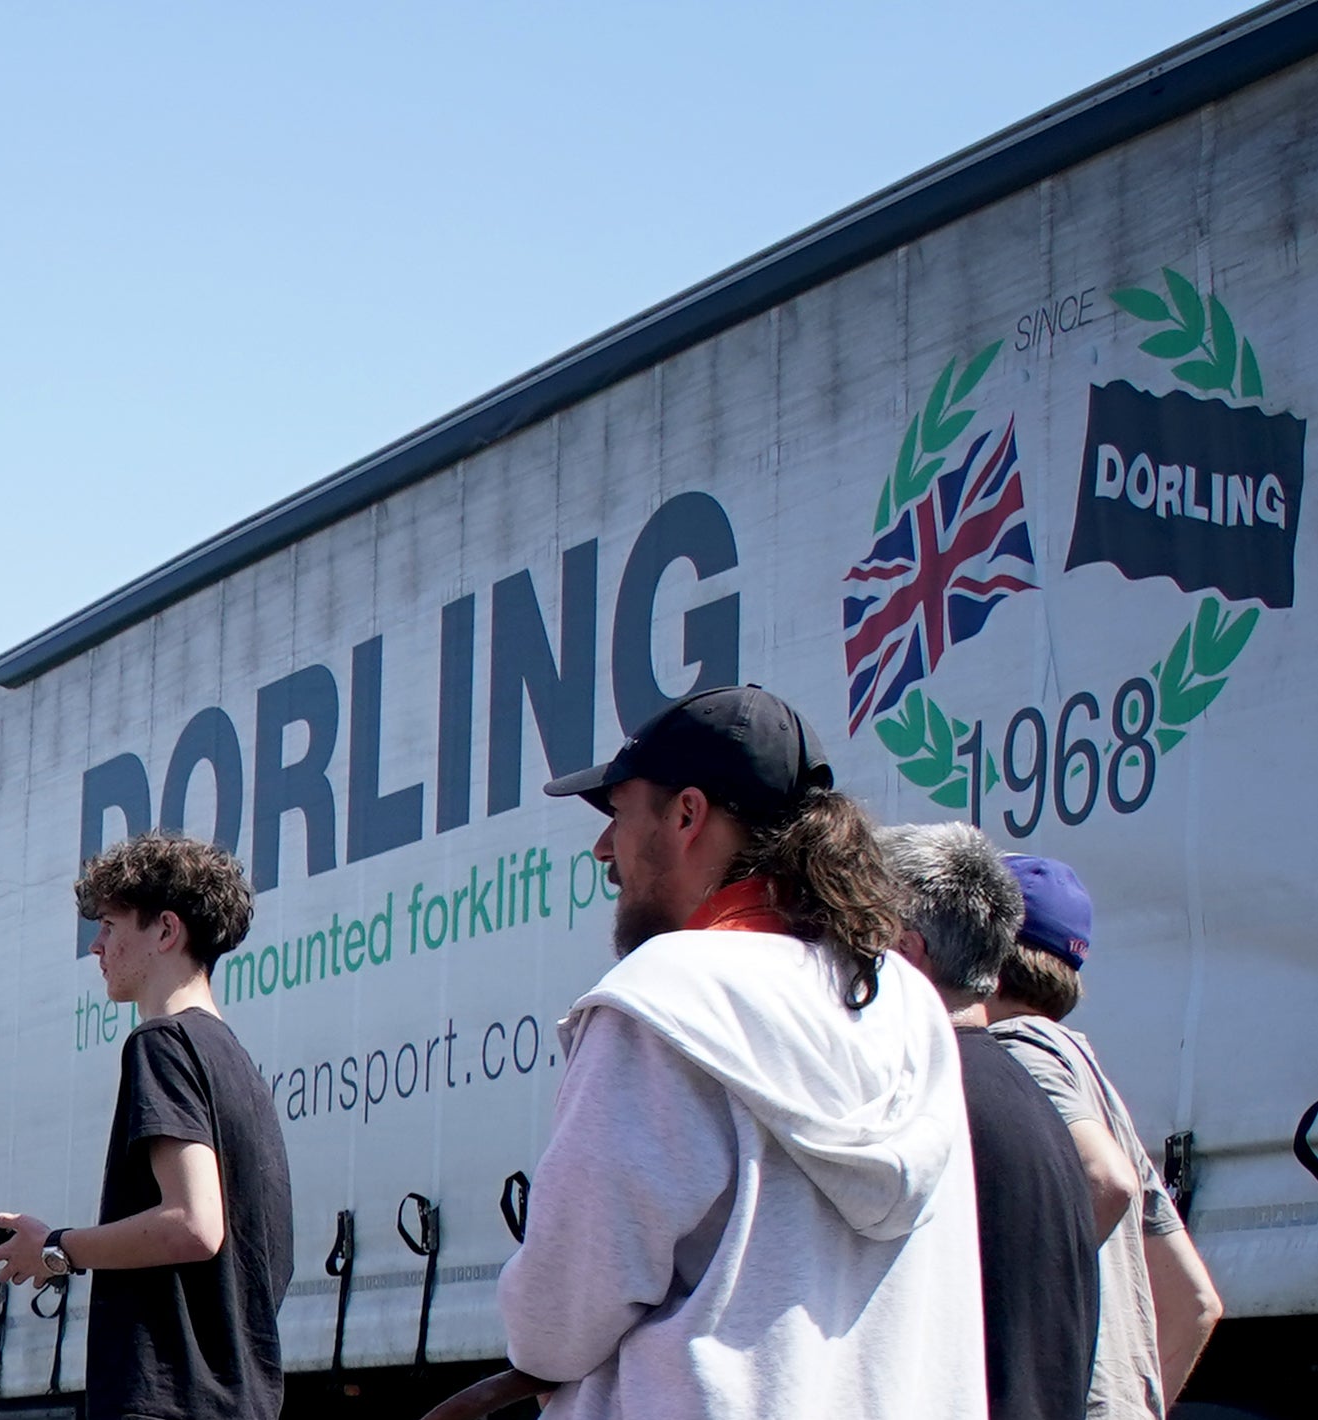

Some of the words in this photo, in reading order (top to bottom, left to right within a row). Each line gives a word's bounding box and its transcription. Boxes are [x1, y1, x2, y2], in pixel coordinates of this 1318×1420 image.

[1014, 286, 1096, 352] SINCE
[1095, 443, 1287, 530] DORLING
[76, 491, 741, 959] DORLING
[956, 677, 1156, 839] 1968
[74, 990, 119, 1052] the
[223, 892, 393, 1006] mounted
[407, 847, 552, 954] forklift
[568, 850, 624, 931] pe
